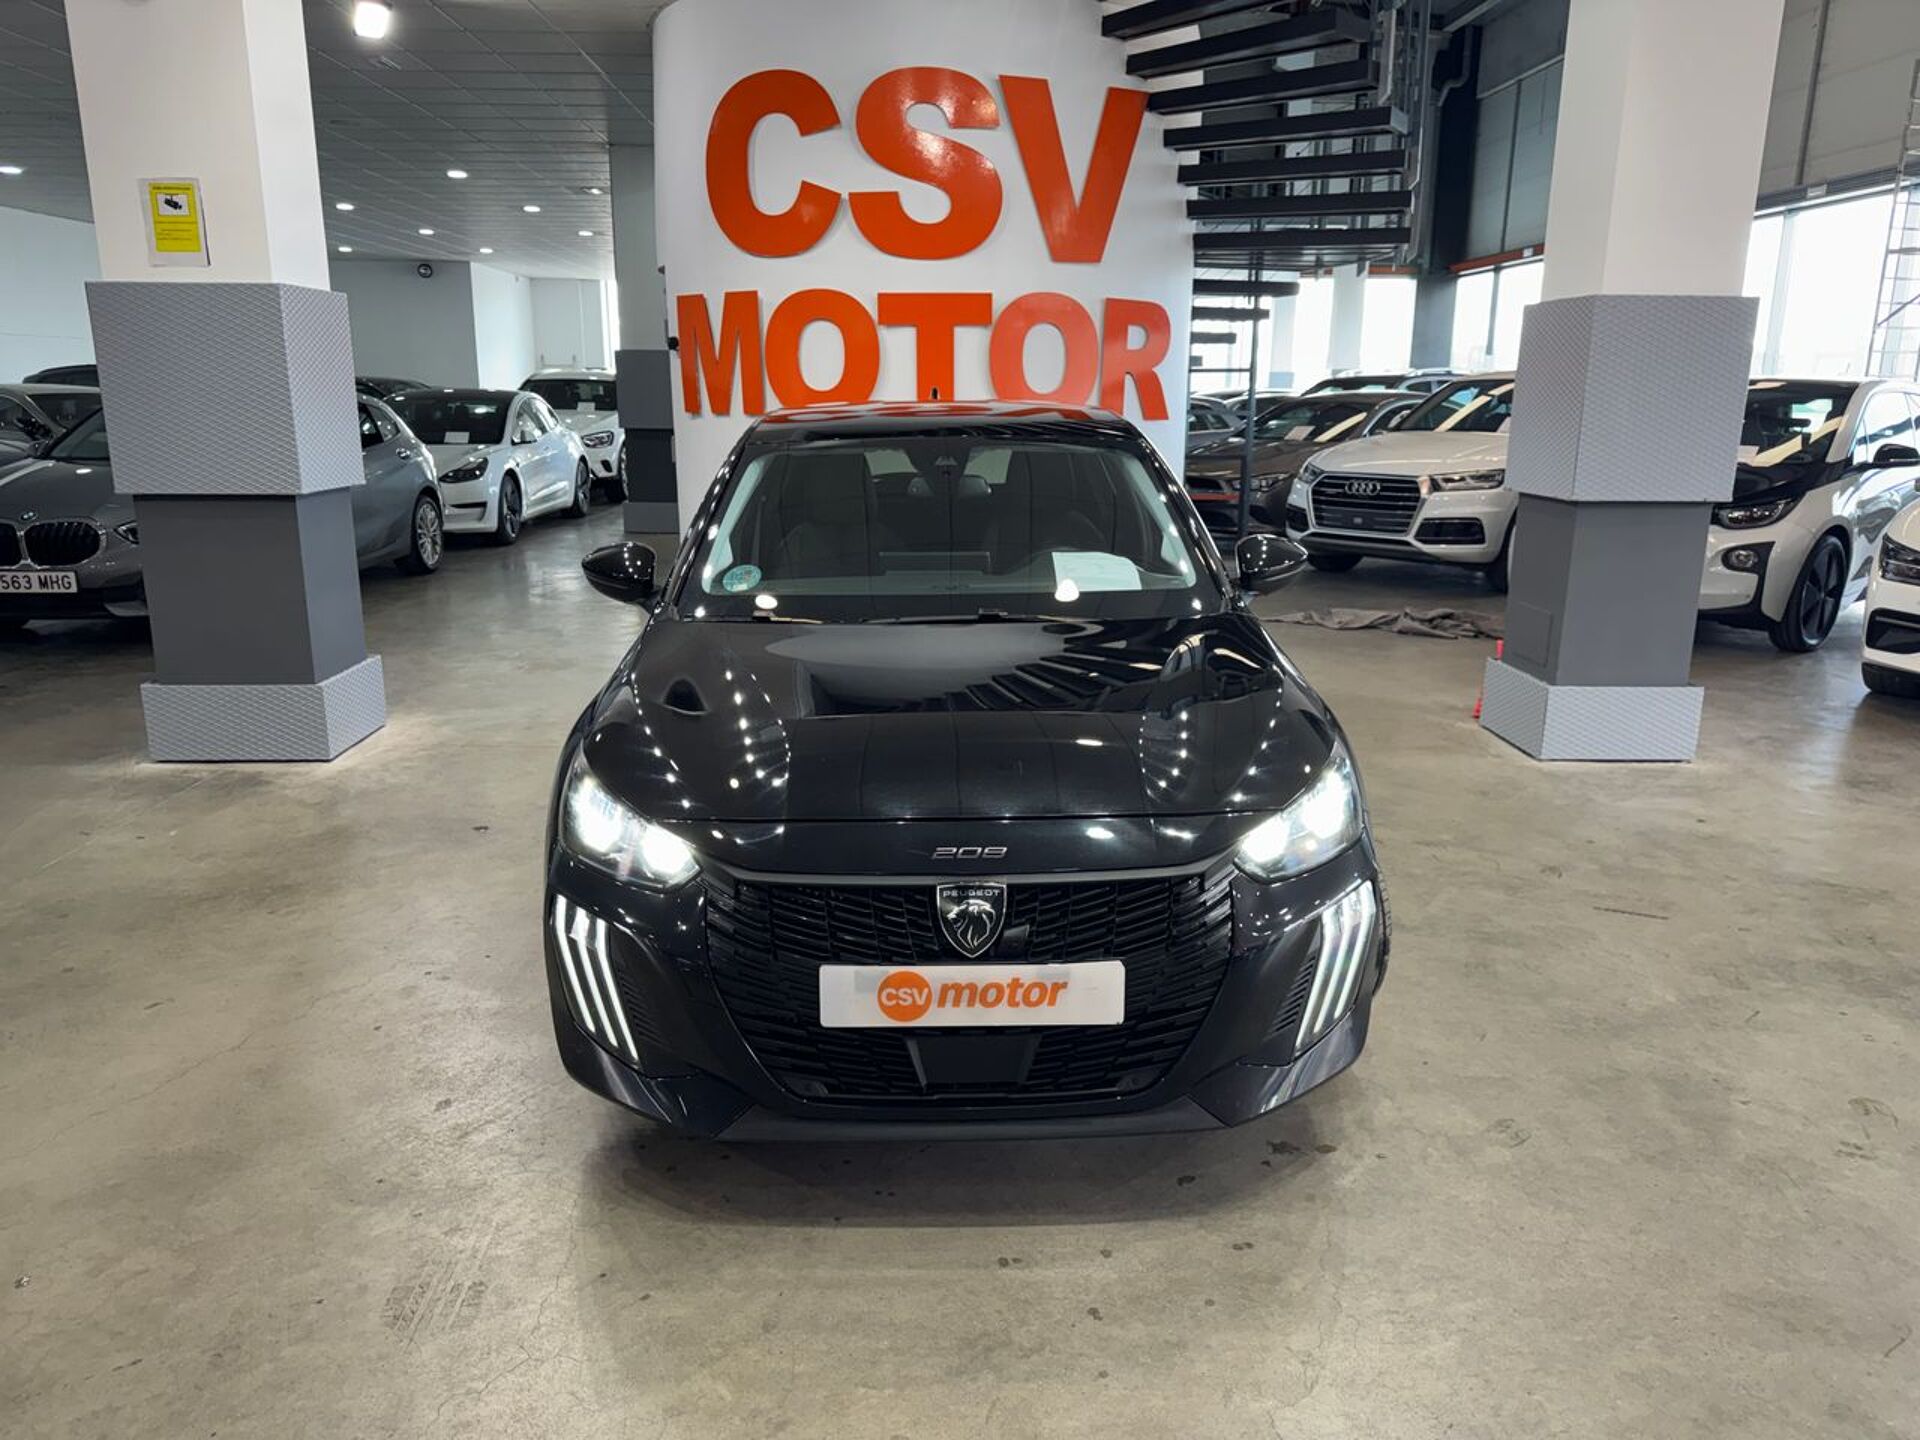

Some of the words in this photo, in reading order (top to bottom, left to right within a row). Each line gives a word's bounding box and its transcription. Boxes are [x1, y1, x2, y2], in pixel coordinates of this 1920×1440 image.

[706, 66, 1151, 263] CSV
[676, 288, 1171, 420] MOTOR
[38, 574, 72, 590] MHG
[931, 846, 1008, 860] 208
[943, 889, 1001, 898] PEUGEOT
[880, 987, 929, 1006] CSV
[937, 976, 1069, 1008] motor
